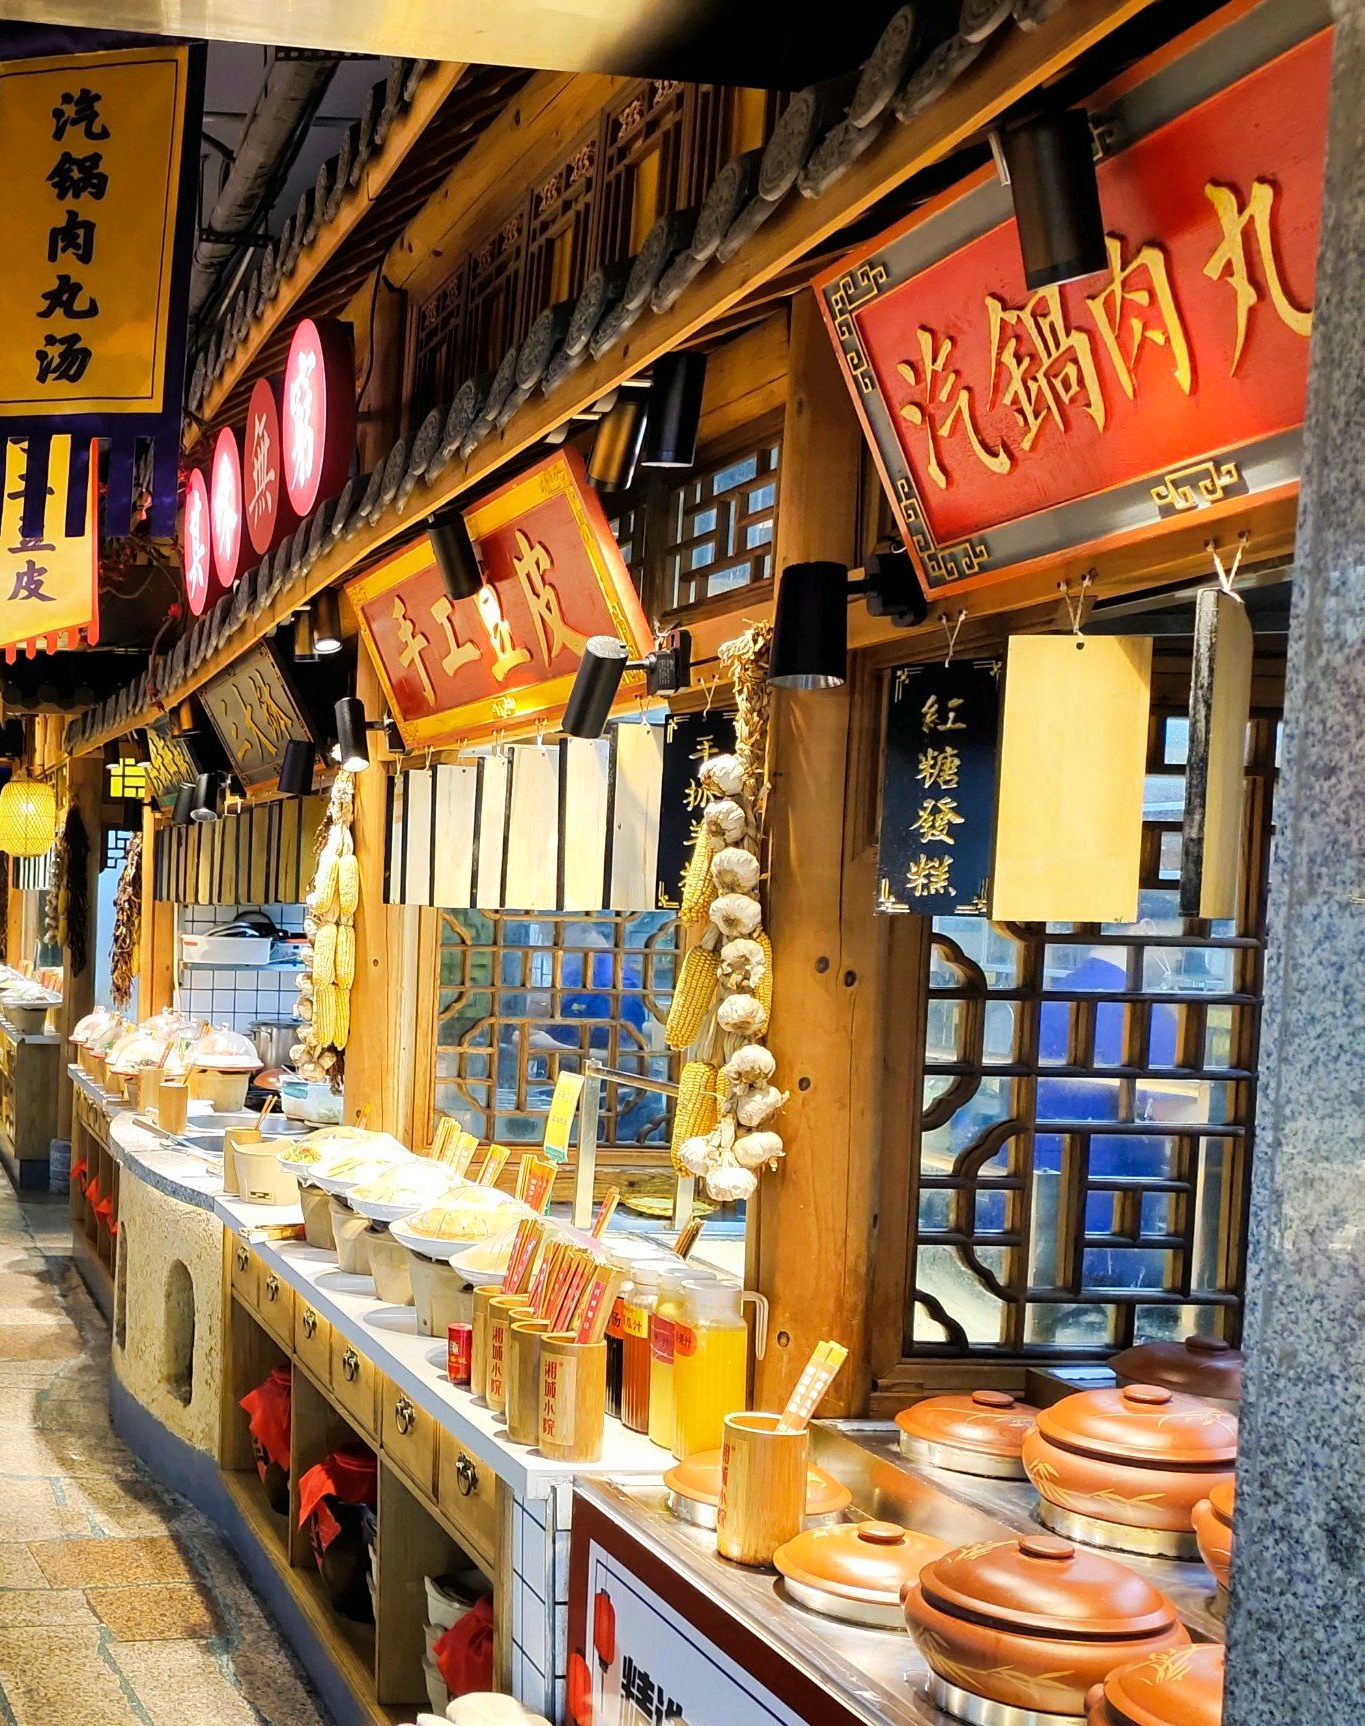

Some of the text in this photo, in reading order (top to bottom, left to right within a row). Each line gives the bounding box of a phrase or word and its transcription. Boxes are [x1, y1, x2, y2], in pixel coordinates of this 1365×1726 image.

[36, 88, 111, 385] 汽锅肉丸汤
[906, 695, 966, 897] 紅糖發糕
